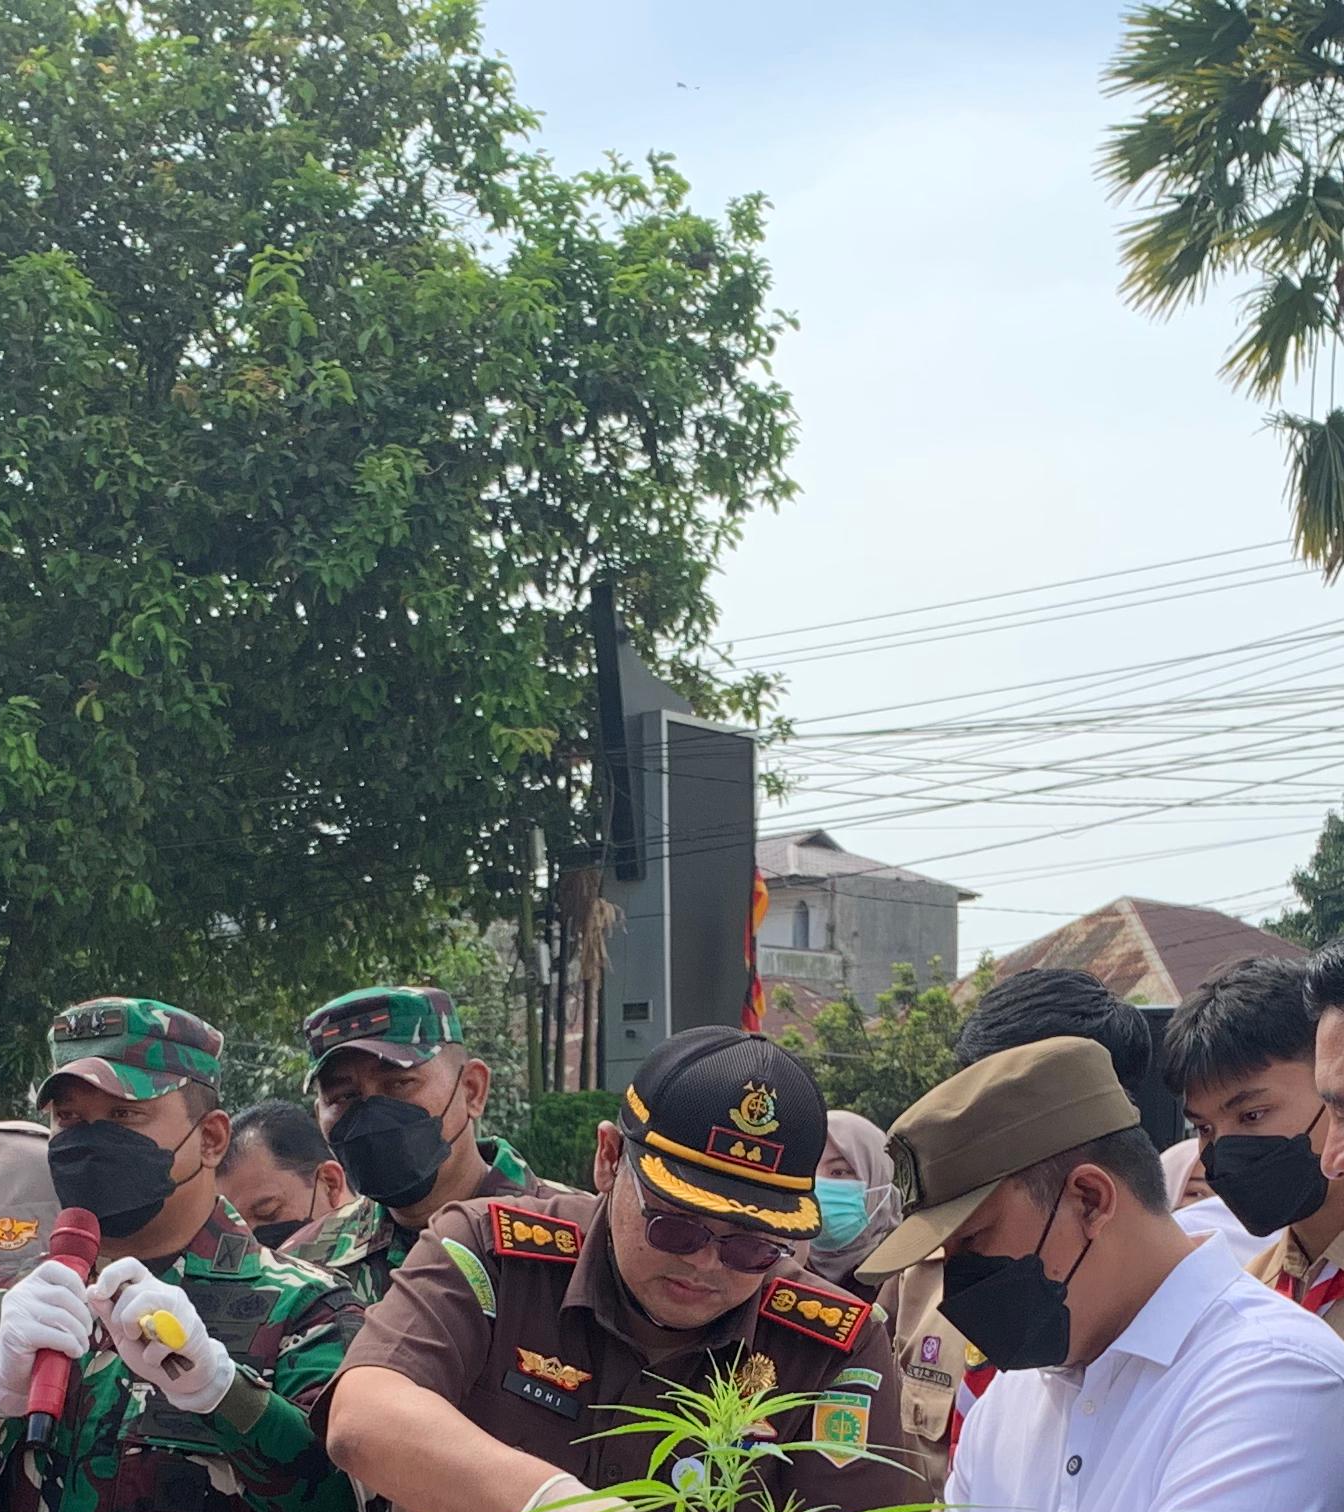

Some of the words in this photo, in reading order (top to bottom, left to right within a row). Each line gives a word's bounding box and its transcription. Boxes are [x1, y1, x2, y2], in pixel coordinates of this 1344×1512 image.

[498, 1209, 515, 1250] JAKSA
[834, 1305, 861, 1342] JAKSA
[523, 1383, 561, 1407] ADHI
